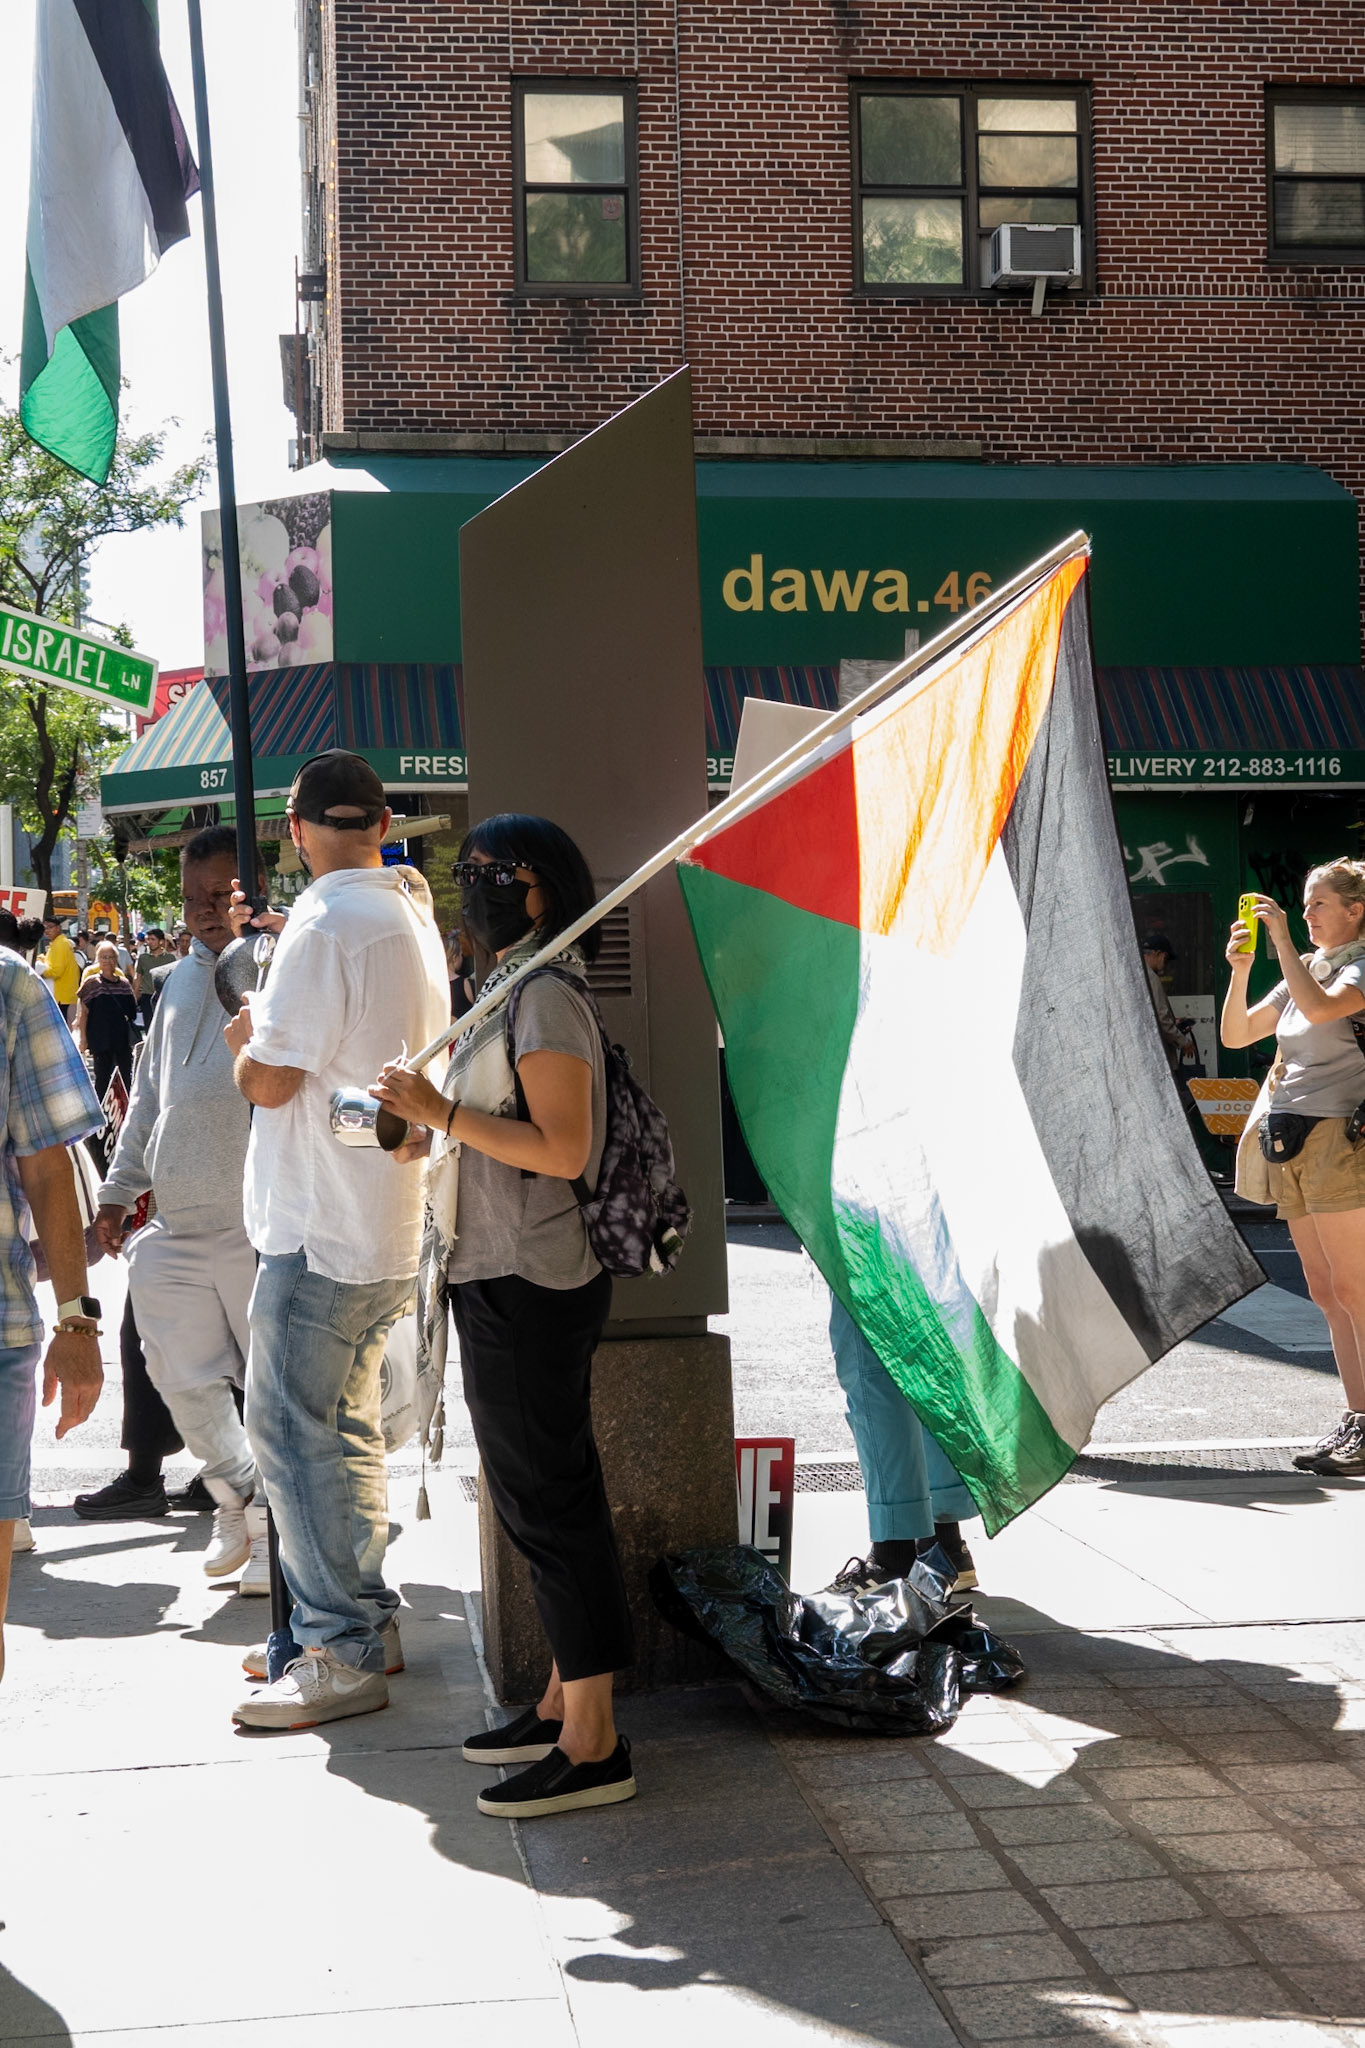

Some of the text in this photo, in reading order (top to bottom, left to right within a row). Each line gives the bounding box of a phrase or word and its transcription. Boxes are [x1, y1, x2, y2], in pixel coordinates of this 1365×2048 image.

[1, 618, 141, 690] ISRAEL LN
[400, 755, 468, 775] FRES
[1107, 758, 1197, 776] LIVERY
[1203, 757, 1342, 777] 212-883-1116
[200, 768, 228, 789] 857
[1215, 1102, 1252, 1112] JOCO
